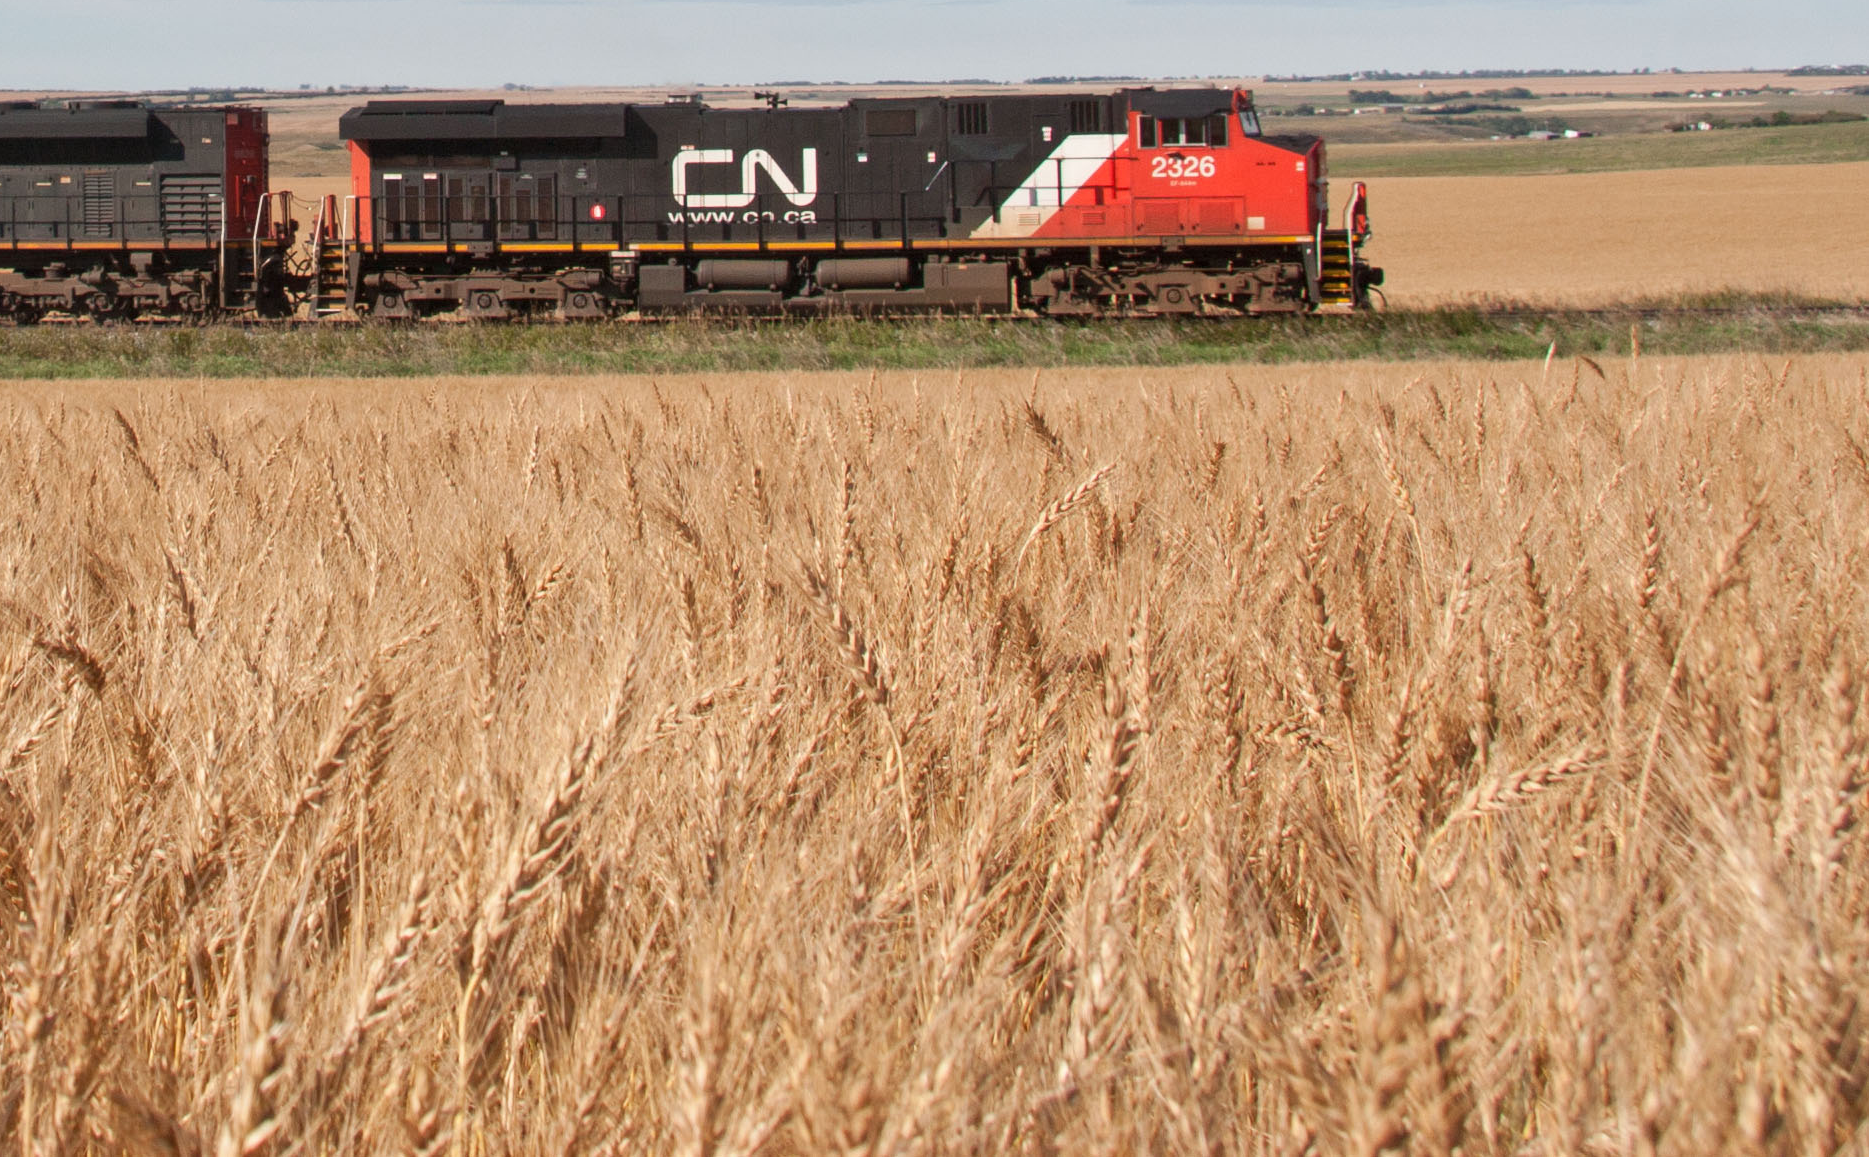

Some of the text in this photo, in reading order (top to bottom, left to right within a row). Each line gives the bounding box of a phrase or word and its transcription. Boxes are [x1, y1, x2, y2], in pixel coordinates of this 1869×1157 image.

[672, 148, 817, 208] CN
[1151, 155, 1216, 178] 2326
[667, 210, 818, 224] www.cn.ca
